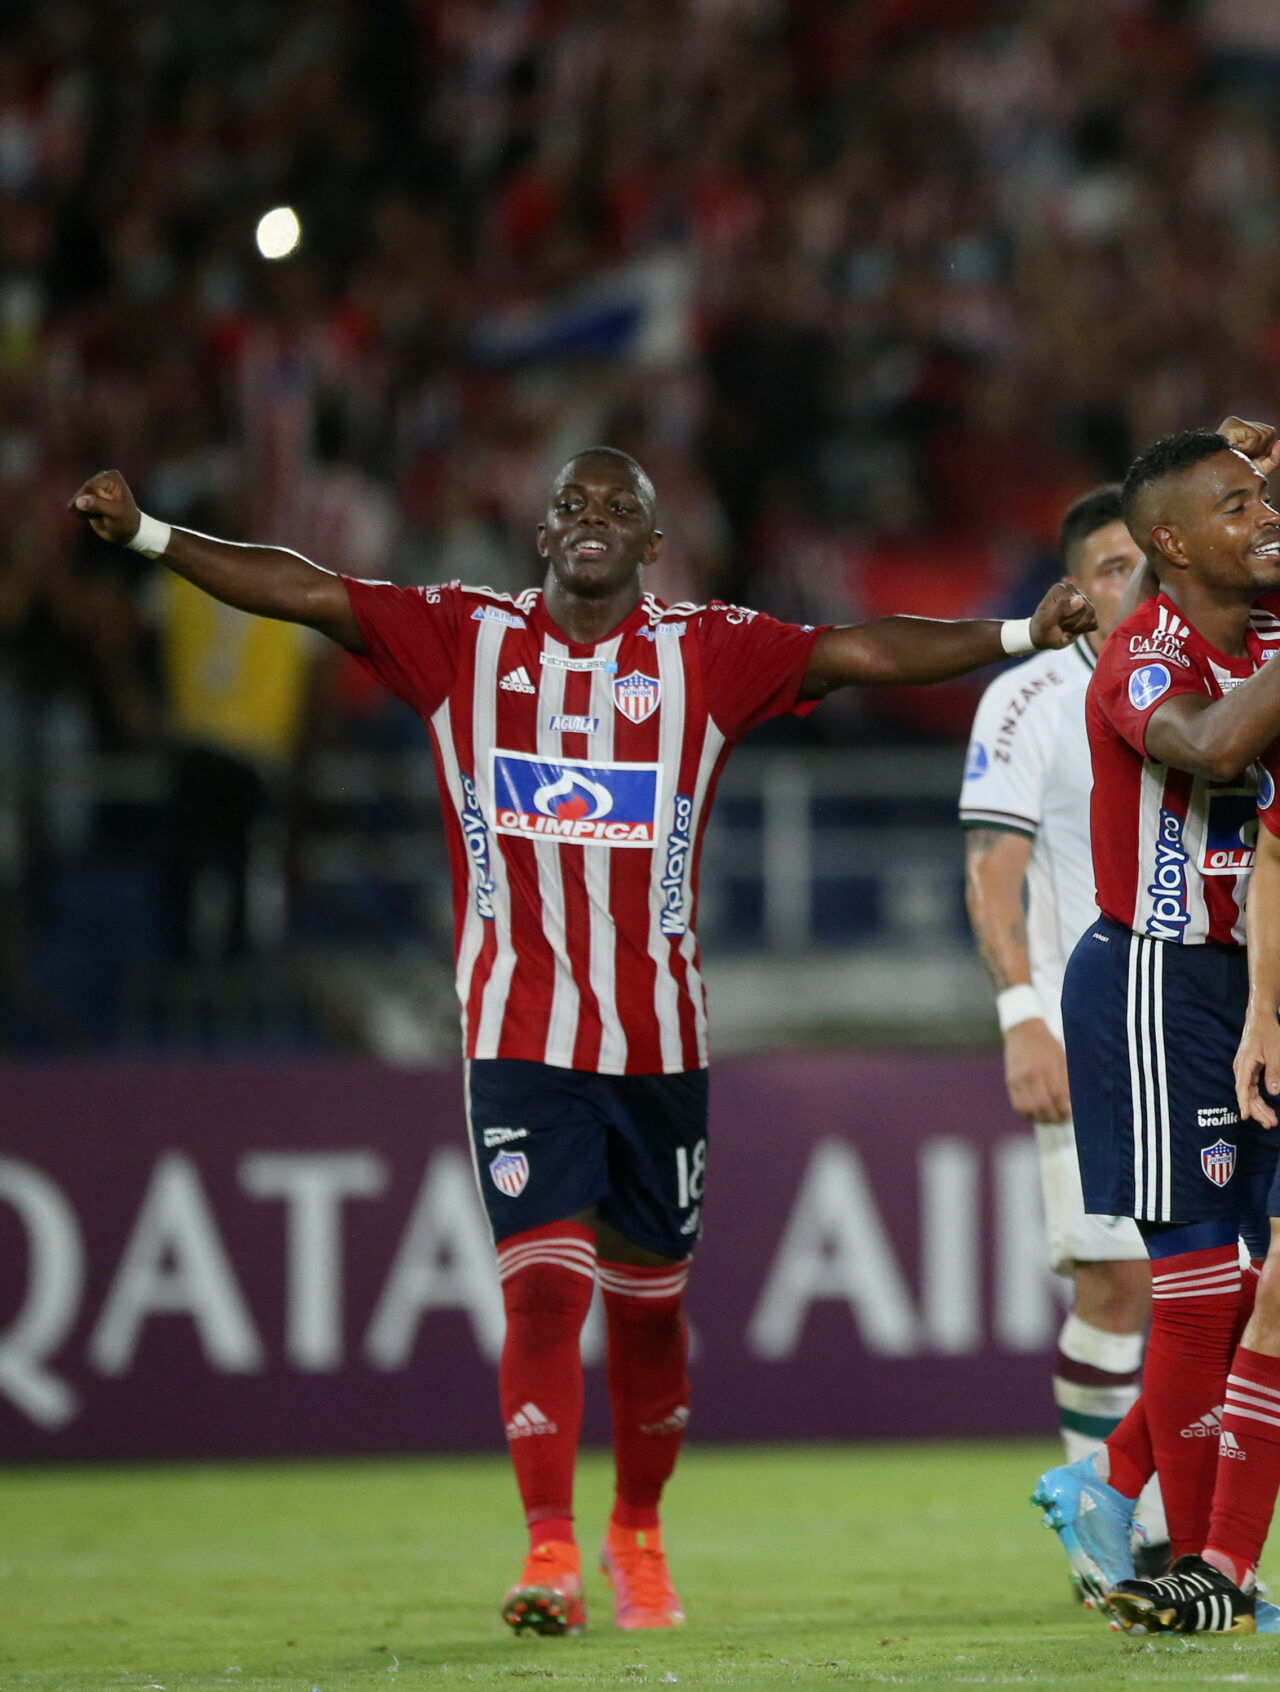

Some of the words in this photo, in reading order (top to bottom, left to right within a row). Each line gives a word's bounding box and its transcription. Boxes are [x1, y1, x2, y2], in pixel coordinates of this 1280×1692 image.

[1129, 635, 1191, 668] CALDAS
[499, 680, 536, 695] adidas
[621, 689, 652, 697] JUNIOR
[551, 717, 596, 732] AGUILA
[500, 811, 650, 841] OLIMPICA
[676, 1139, 707, 1208] 18
